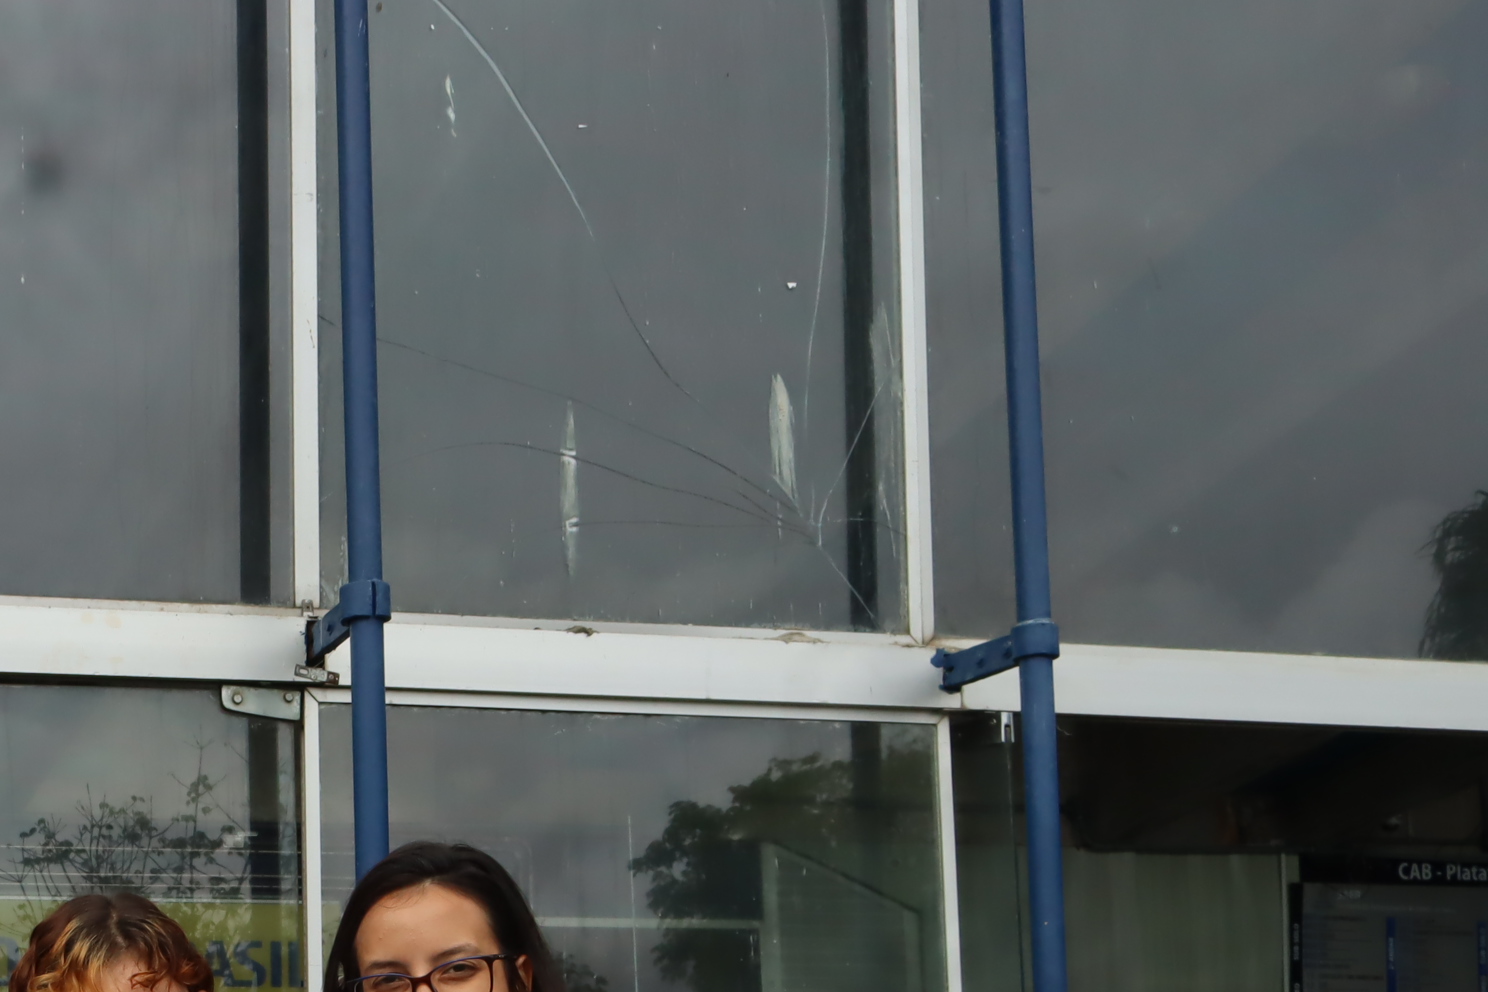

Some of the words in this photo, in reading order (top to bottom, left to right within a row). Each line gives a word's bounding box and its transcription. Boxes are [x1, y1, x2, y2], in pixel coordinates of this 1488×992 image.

[1398, 862, 1432, 880] CAB
[1446, 863, 1488, 881] Plata
[206, 941, 304, 988] ASIL
